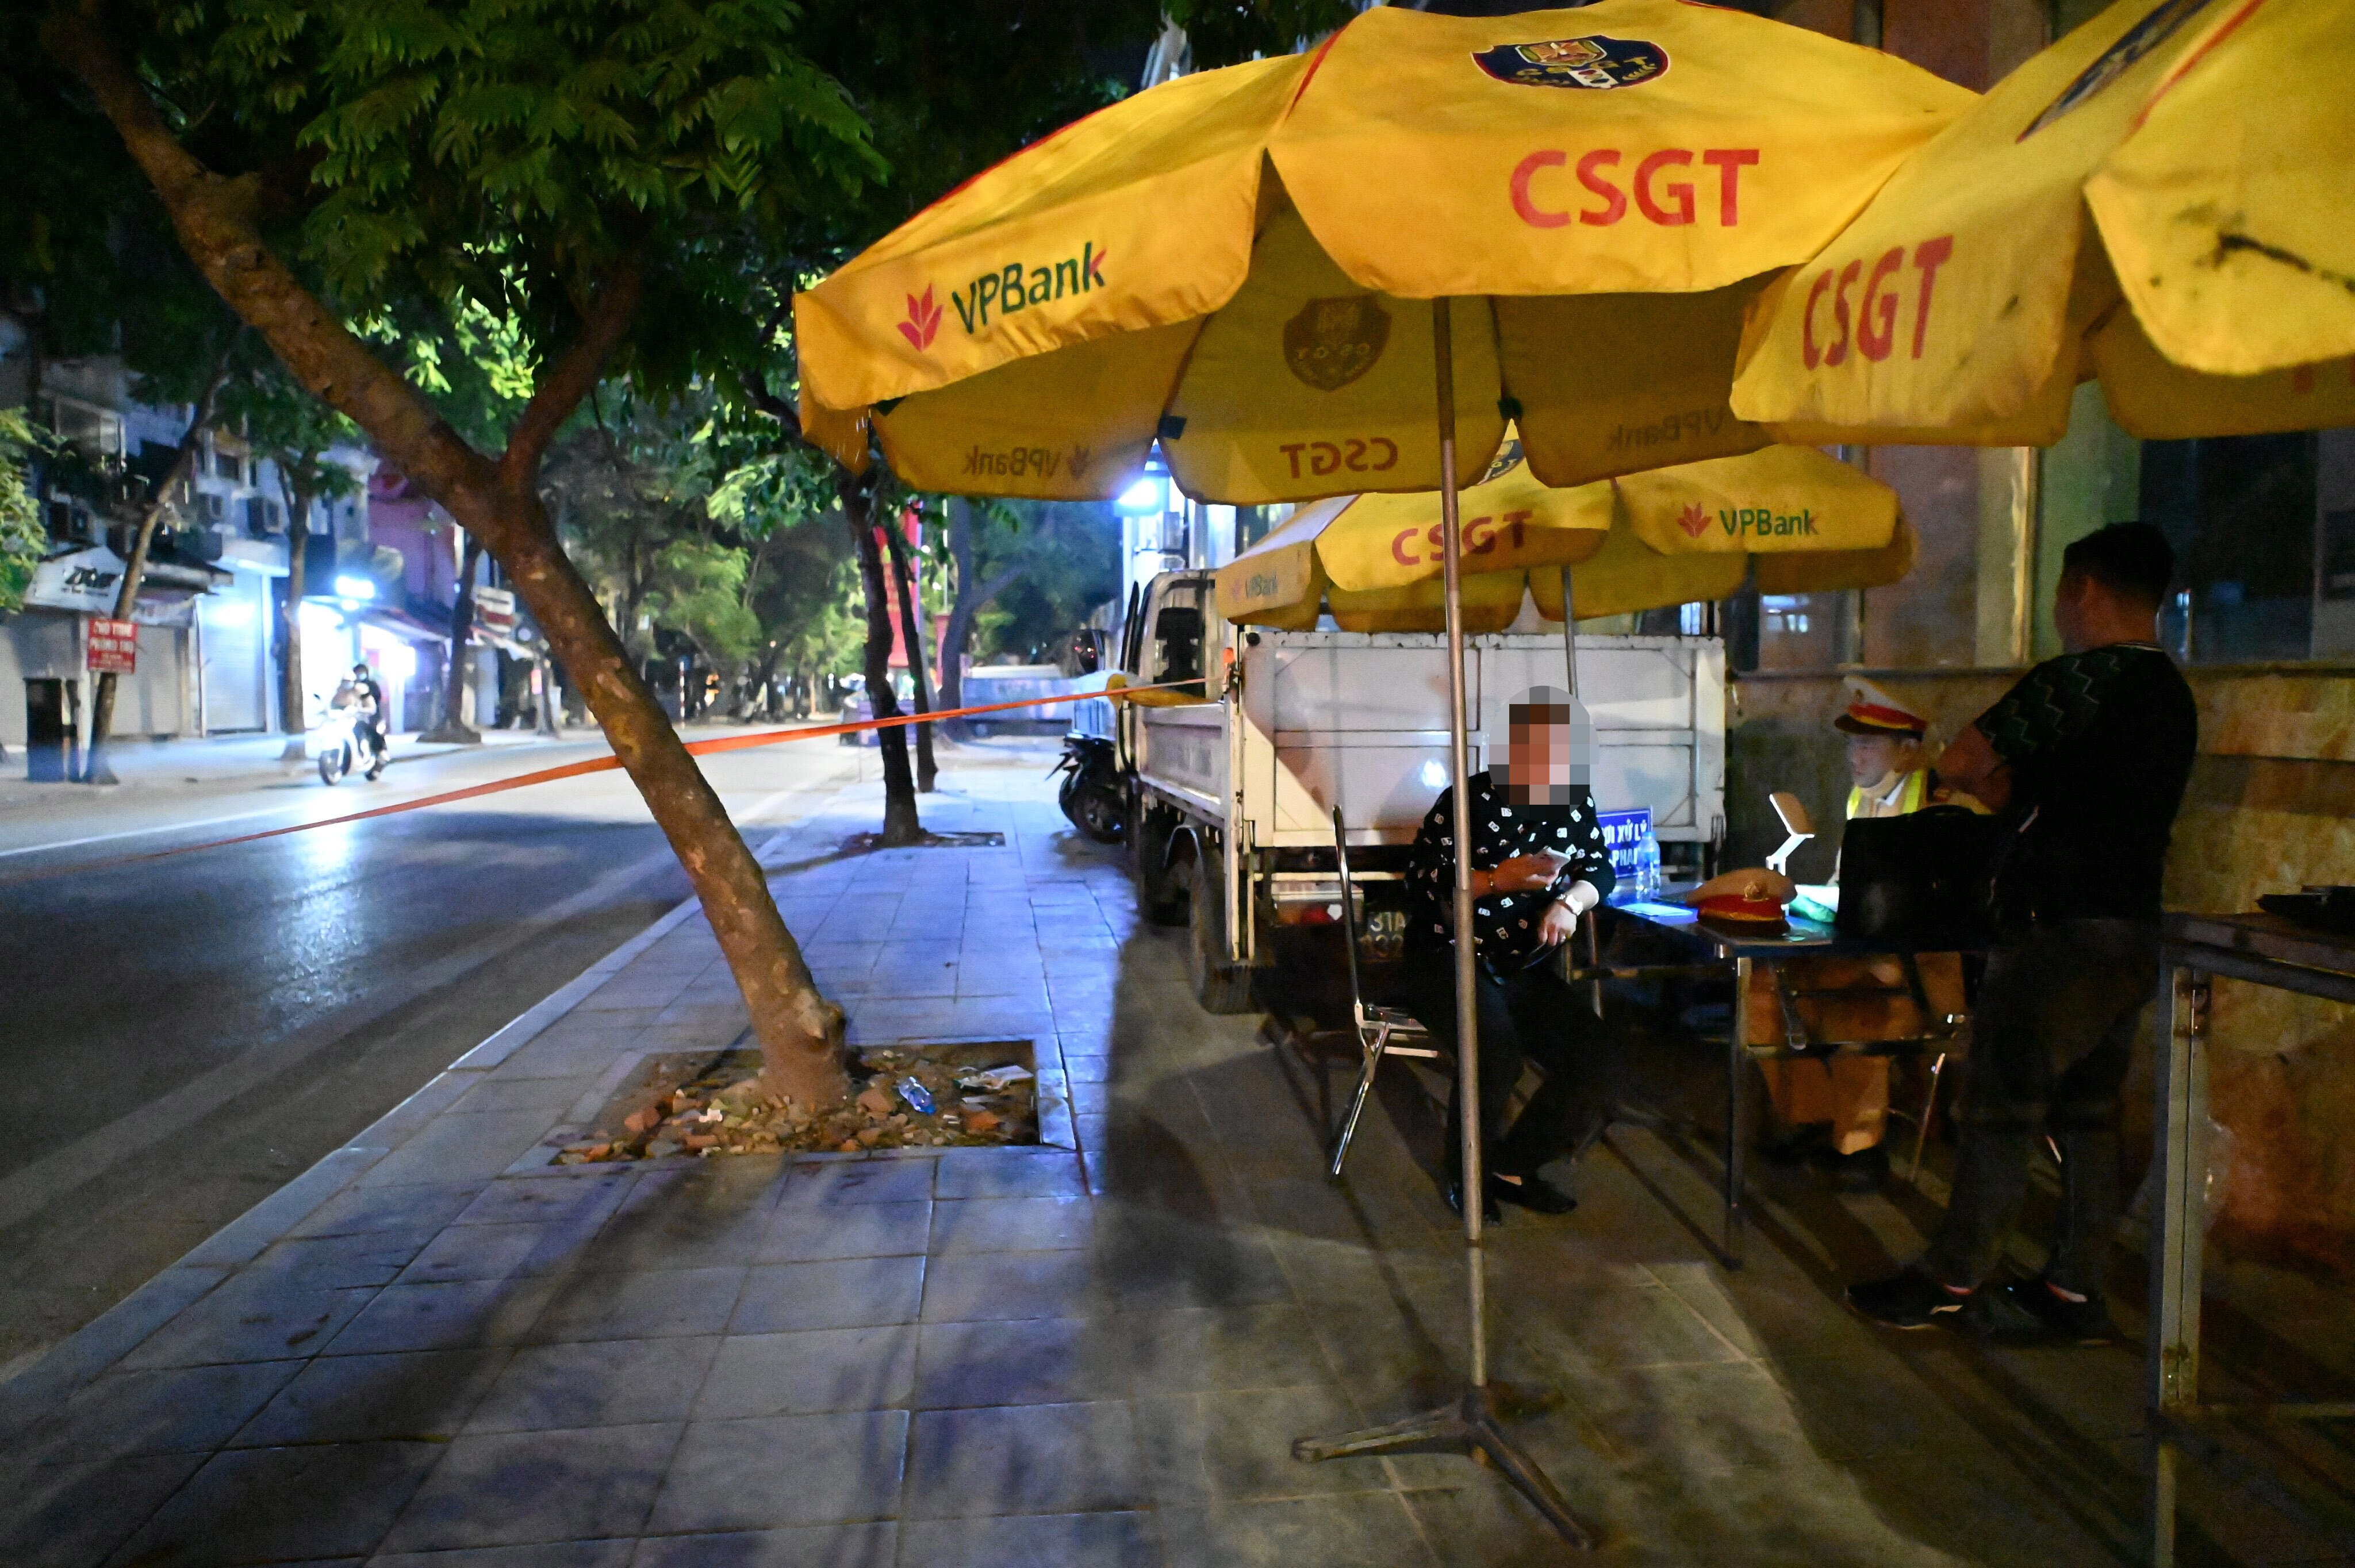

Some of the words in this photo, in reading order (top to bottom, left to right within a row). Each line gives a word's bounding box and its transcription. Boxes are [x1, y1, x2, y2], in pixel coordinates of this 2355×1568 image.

[1511, 149, 1759, 228] CSGT
[952, 241, 1107, 335] VPBank
[1802, 235, 1954, 371] CSGT
[1392, 510, 1534, 566] CSGT
[1719, 509, 1819, 536] VPBank
